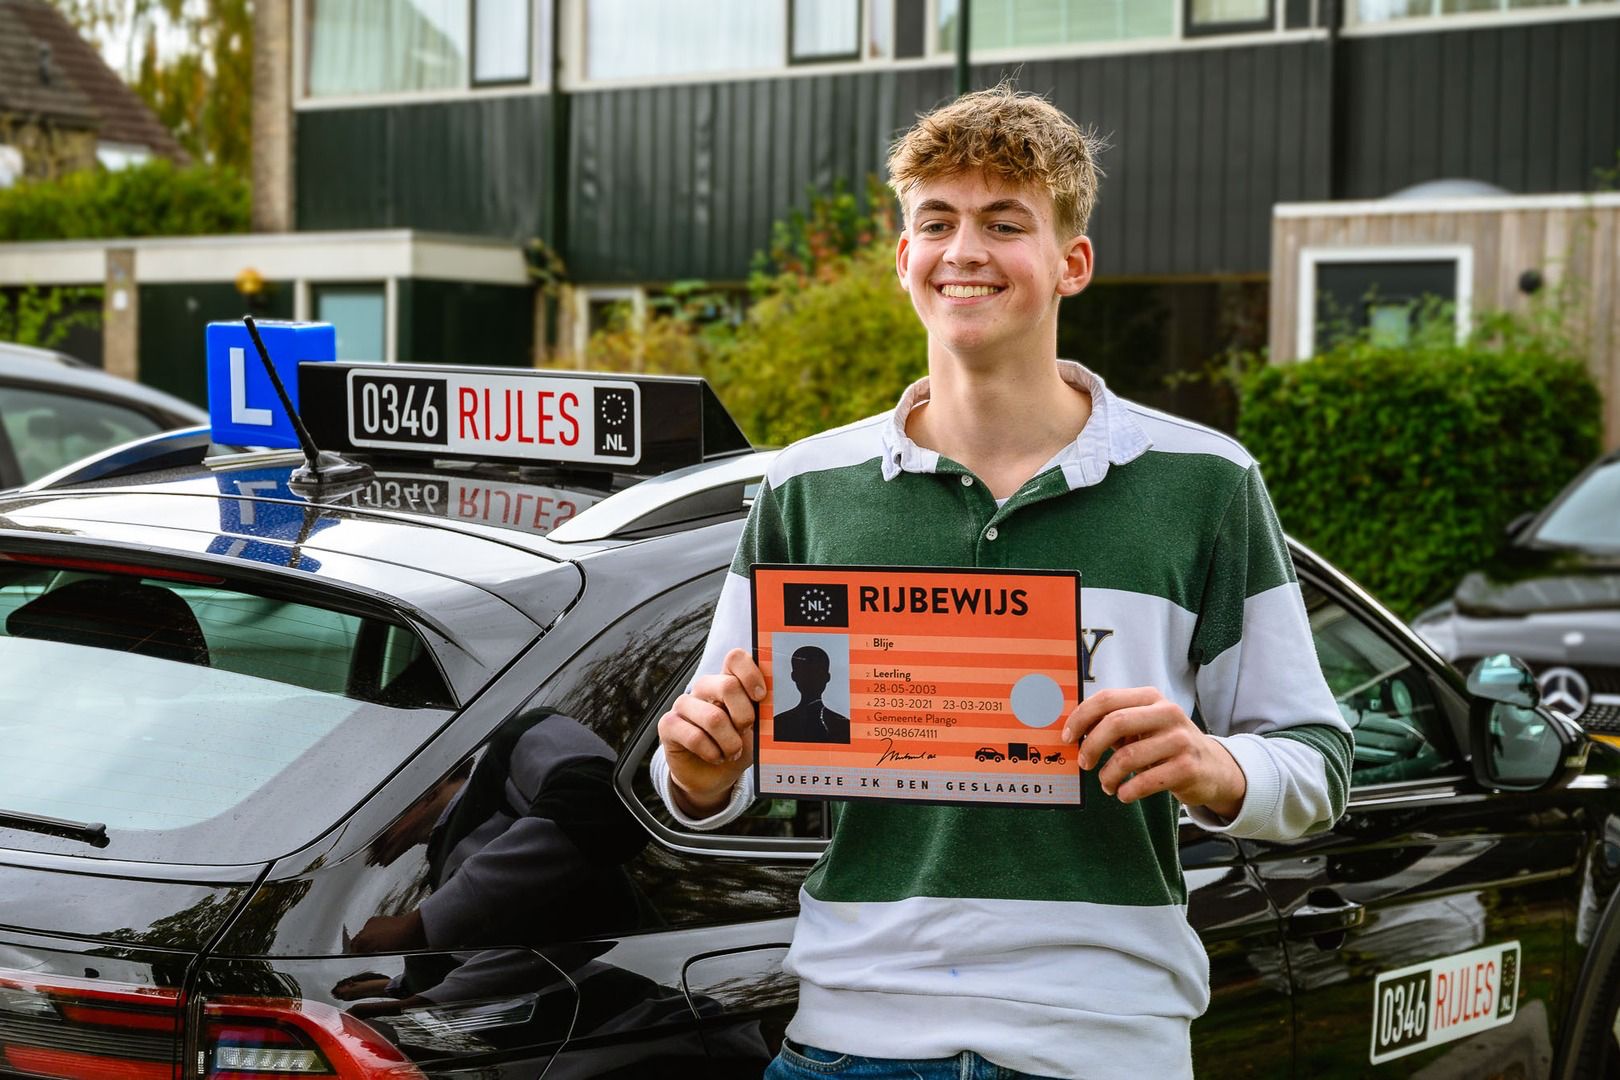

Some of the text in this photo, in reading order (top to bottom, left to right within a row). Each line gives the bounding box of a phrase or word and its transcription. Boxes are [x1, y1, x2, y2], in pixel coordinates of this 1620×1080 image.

[229, 346, 273, 427] L
[362, 382, 580, 447] 0346 RIJLES
[602, 433, 628, 451] .NL
[807, 599, 826, 613] NL
[859, 585, 1029, 617] RIJBEWIJS
[872, 637, 895, 651] Blije
[873, 668, 912, 682] Leerling
[873, 683, 937, 695] 28-05-2003
[873, 697, 932, 709] 23-03-2021
[942, 699, 1003, 711] 23-03-2031
[873, 712, 923, 724] Gemeente
[925, 713, 958, 727] Plango
[874, 727, 938, 738] 50948674111
[776, 774, 1053, 794] JOEPIE IK BEN GESLAAGD!
[1380, 961, 1496, 1047] 0346 RIJLES
